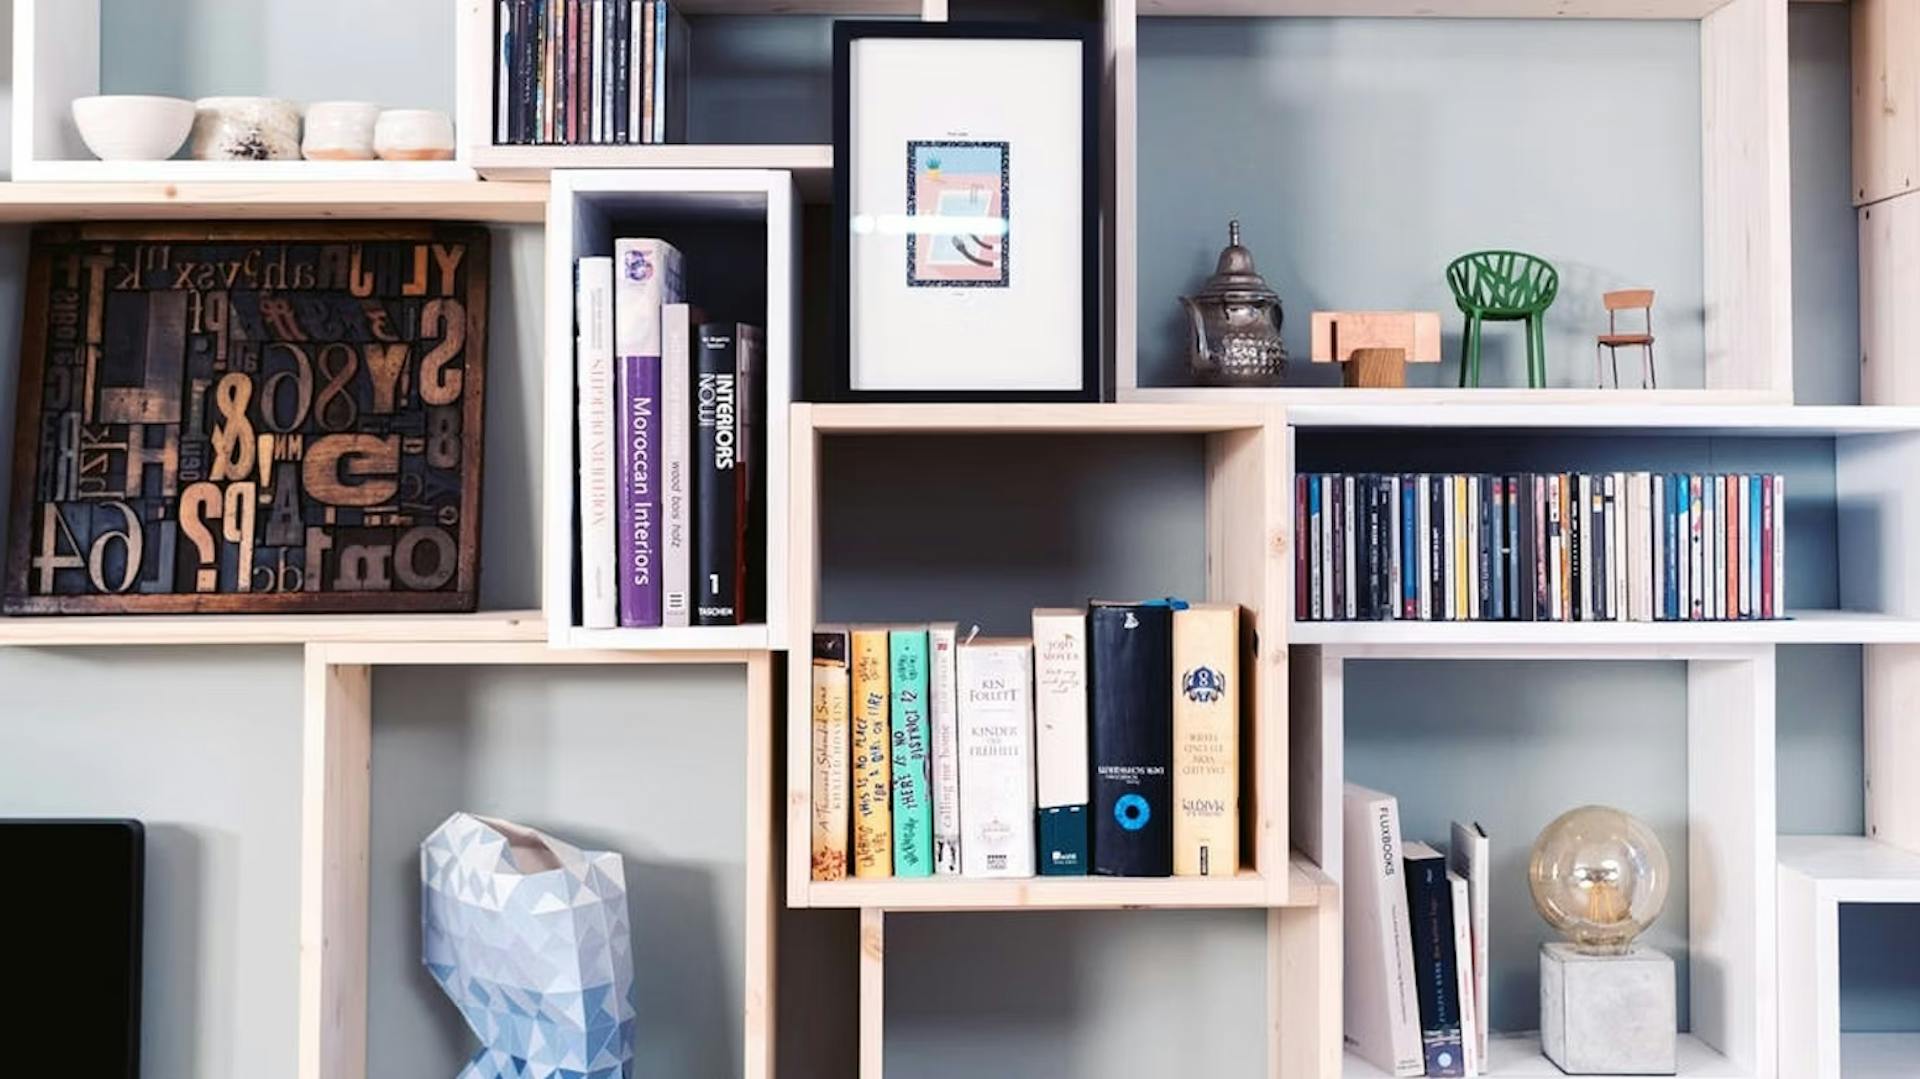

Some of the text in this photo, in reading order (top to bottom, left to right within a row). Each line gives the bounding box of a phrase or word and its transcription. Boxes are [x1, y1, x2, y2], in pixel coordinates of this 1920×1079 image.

[714, 373, 735, 470] INTERIORS
[632, 397, 653, 586] Moroccan Interiors
[670, 461, 682, 493] wood
[709, 573, 720, 595] 1
[981, 679, 1006, 689] KEN
[1199, 669, 1209, 686] 8
[1379, 806, 1395, 877] FLUXBOOKS
